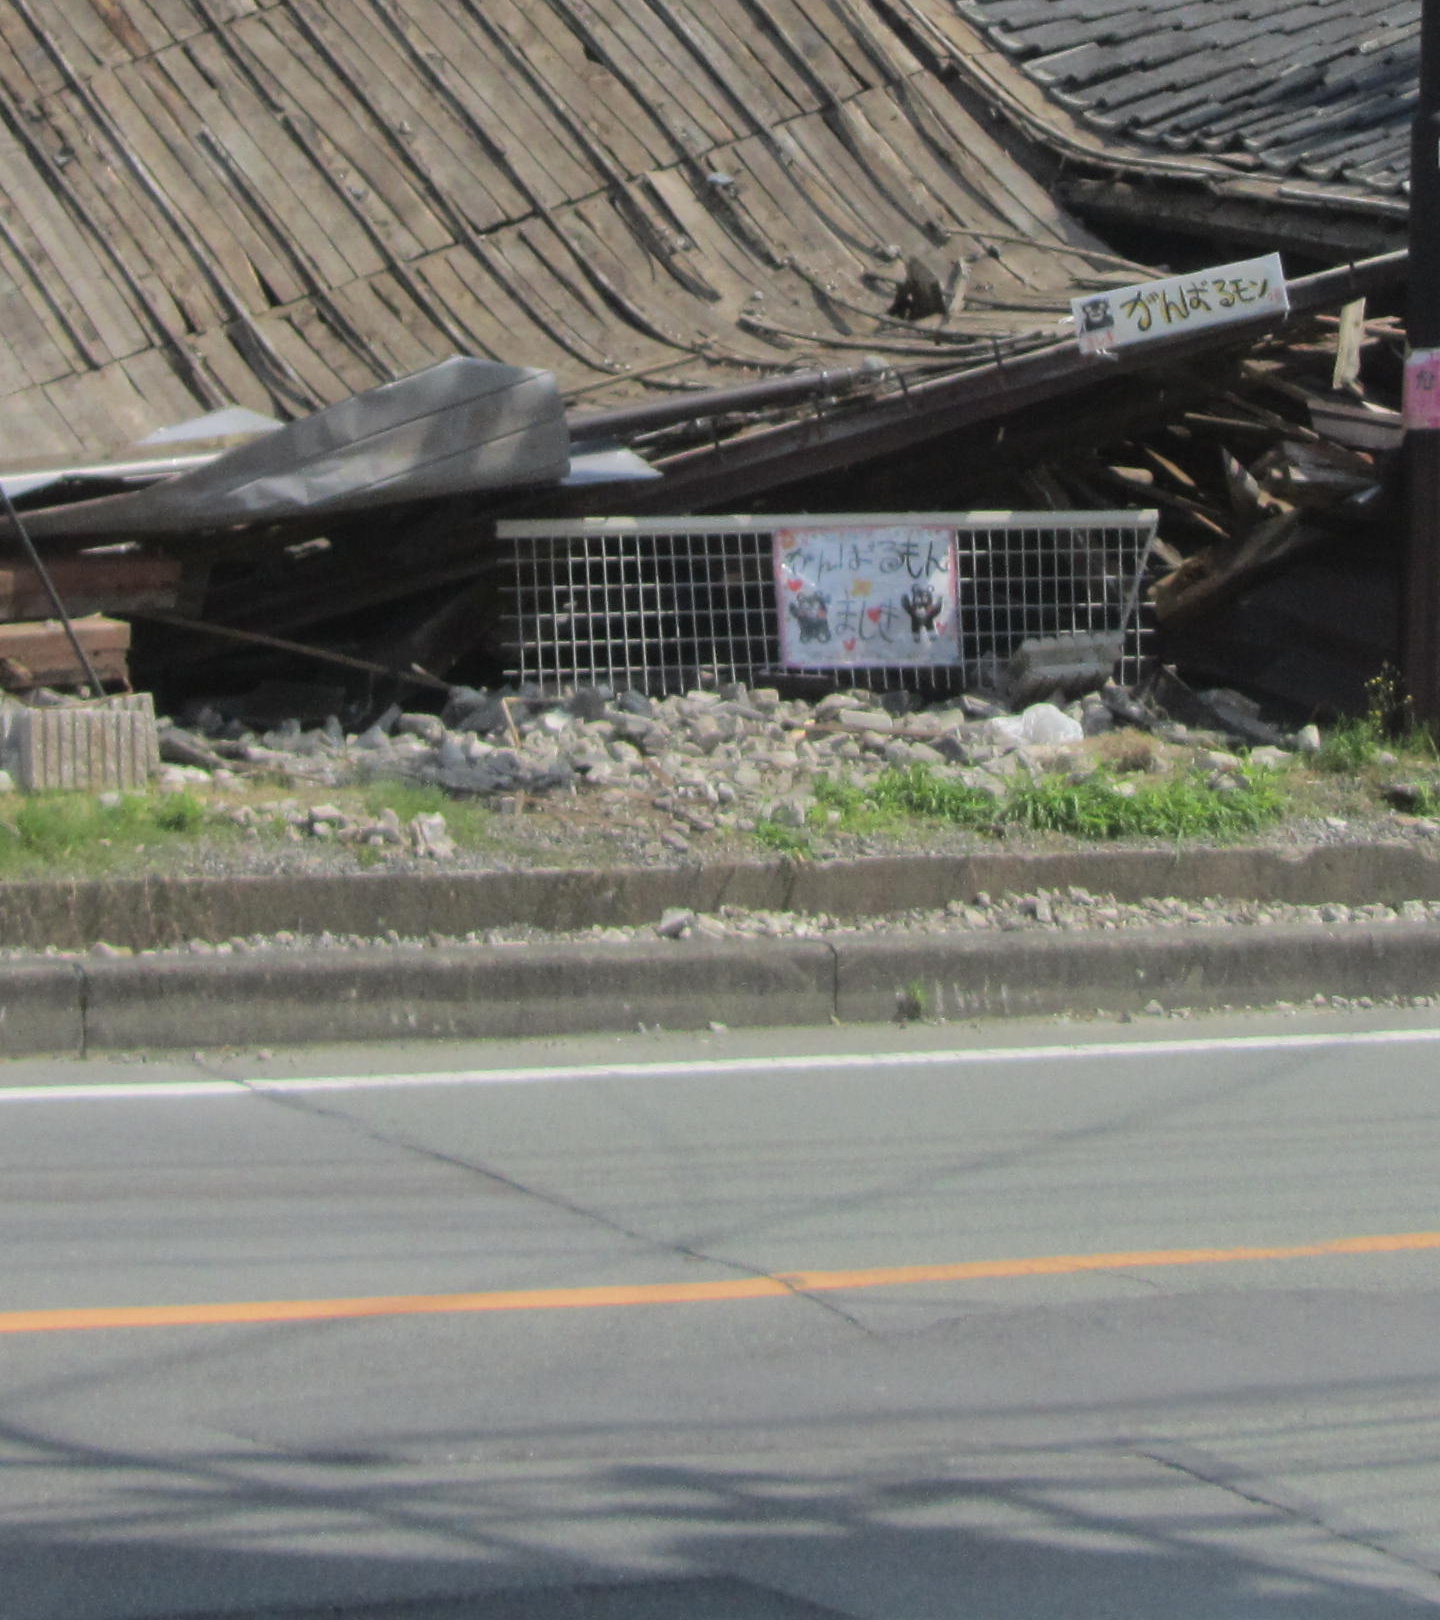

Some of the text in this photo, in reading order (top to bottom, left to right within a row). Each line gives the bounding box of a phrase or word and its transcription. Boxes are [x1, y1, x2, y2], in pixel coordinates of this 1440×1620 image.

[1119, 277, 1269, 332] がんばるモン
